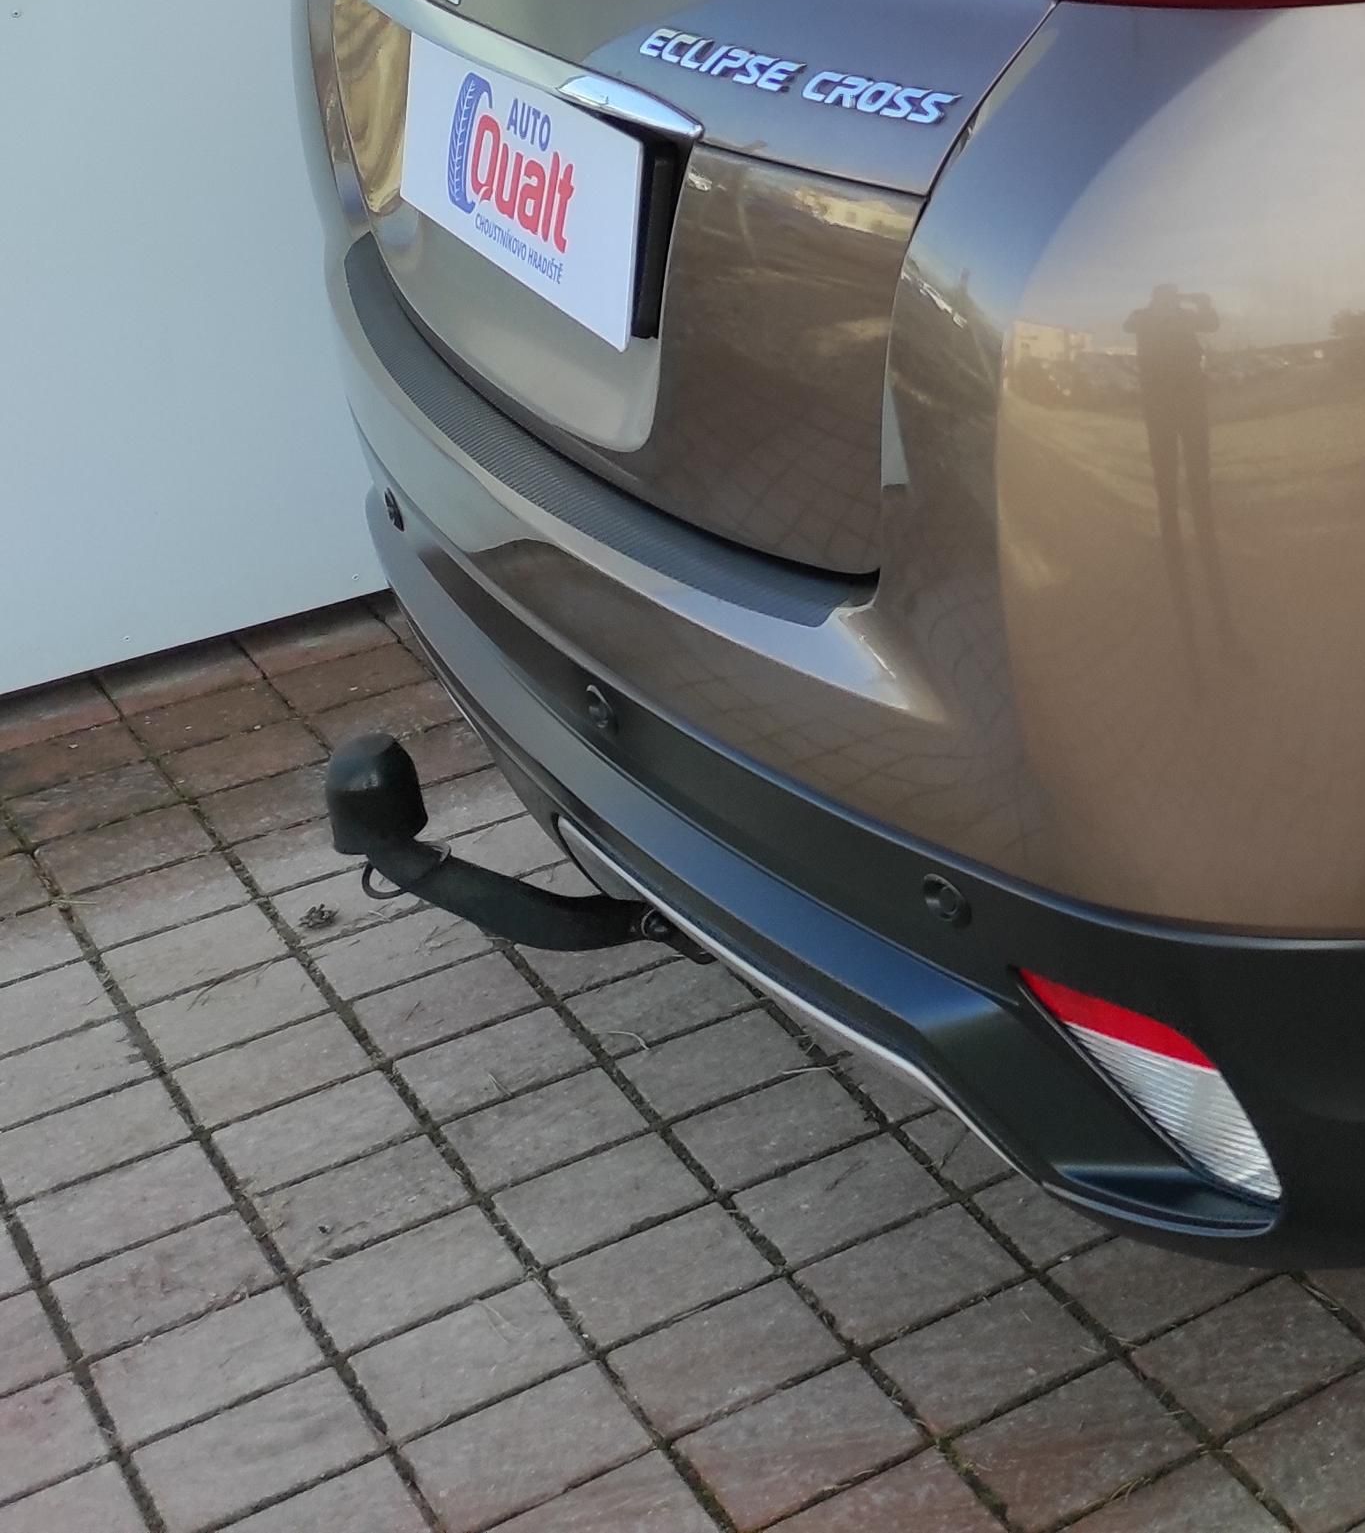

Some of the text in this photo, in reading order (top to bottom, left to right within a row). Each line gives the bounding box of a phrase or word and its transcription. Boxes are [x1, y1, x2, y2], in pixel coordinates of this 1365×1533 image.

[638, 26, 960, 125] ECLIPSE CROSS
[506, 97, 552, 152] AUTO
[471, 114, 575, 253] Qualt
[474, 213, 527, 261] CHOUSTNÍKOVO
